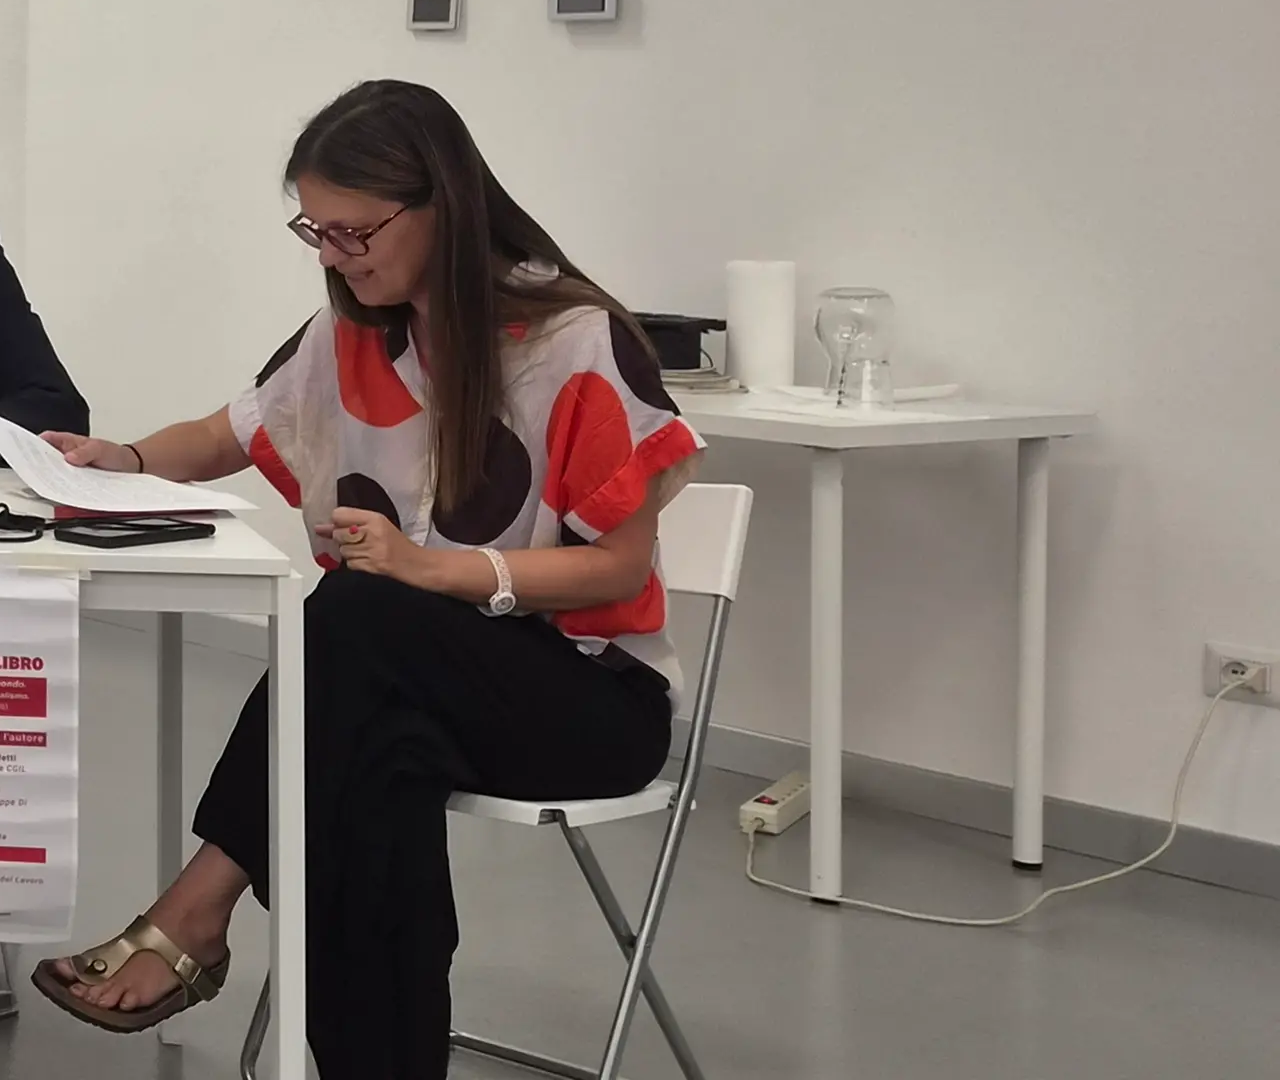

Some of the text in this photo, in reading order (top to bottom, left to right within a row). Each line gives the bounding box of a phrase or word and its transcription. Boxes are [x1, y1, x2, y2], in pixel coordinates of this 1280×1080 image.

[3, 731, 44, 743] l'autore
[6, 764, 26, 772] CGIL
[18, 798, 28, 806] Di
